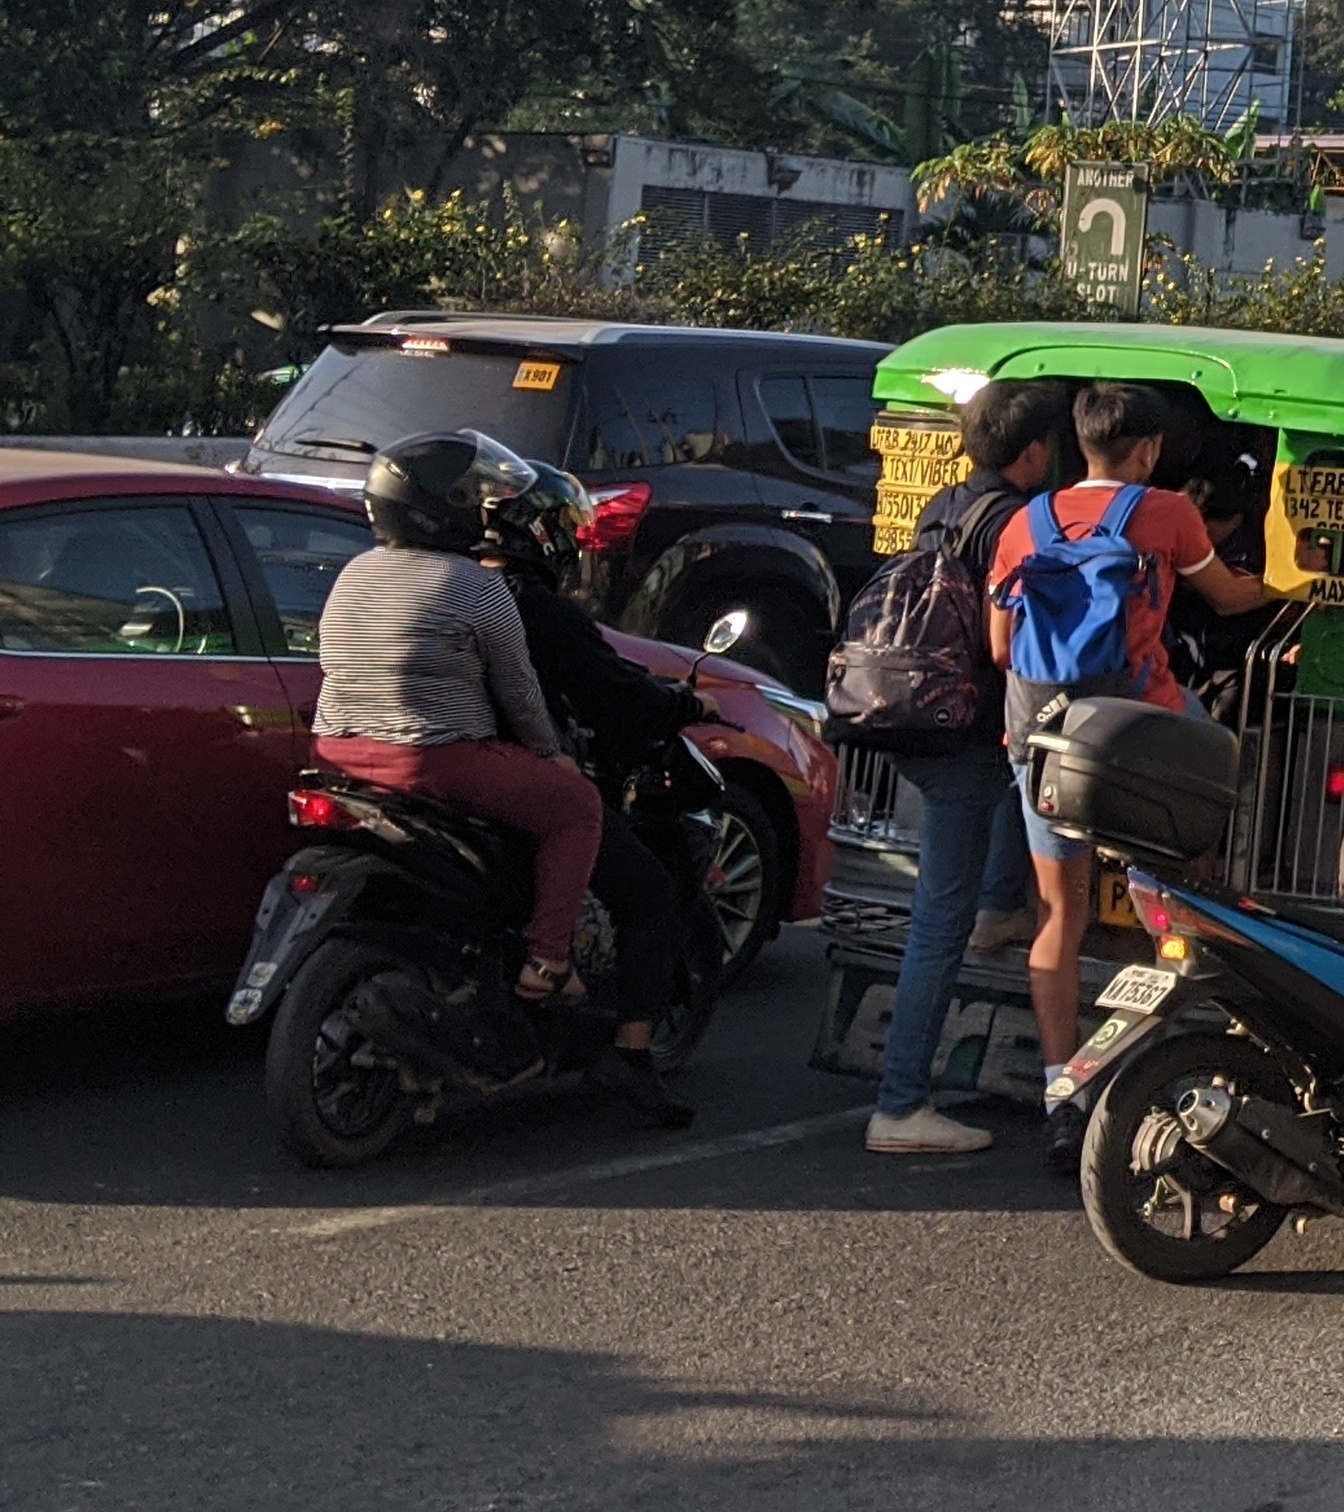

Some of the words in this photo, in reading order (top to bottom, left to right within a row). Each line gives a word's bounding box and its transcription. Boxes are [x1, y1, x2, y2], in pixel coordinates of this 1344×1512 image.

[1077, 169, 1134, 188] ANOTHER
[1067, 260, 1129, 282] U-TURN
[890, 456, 960, 486] TEXT/VIBER
